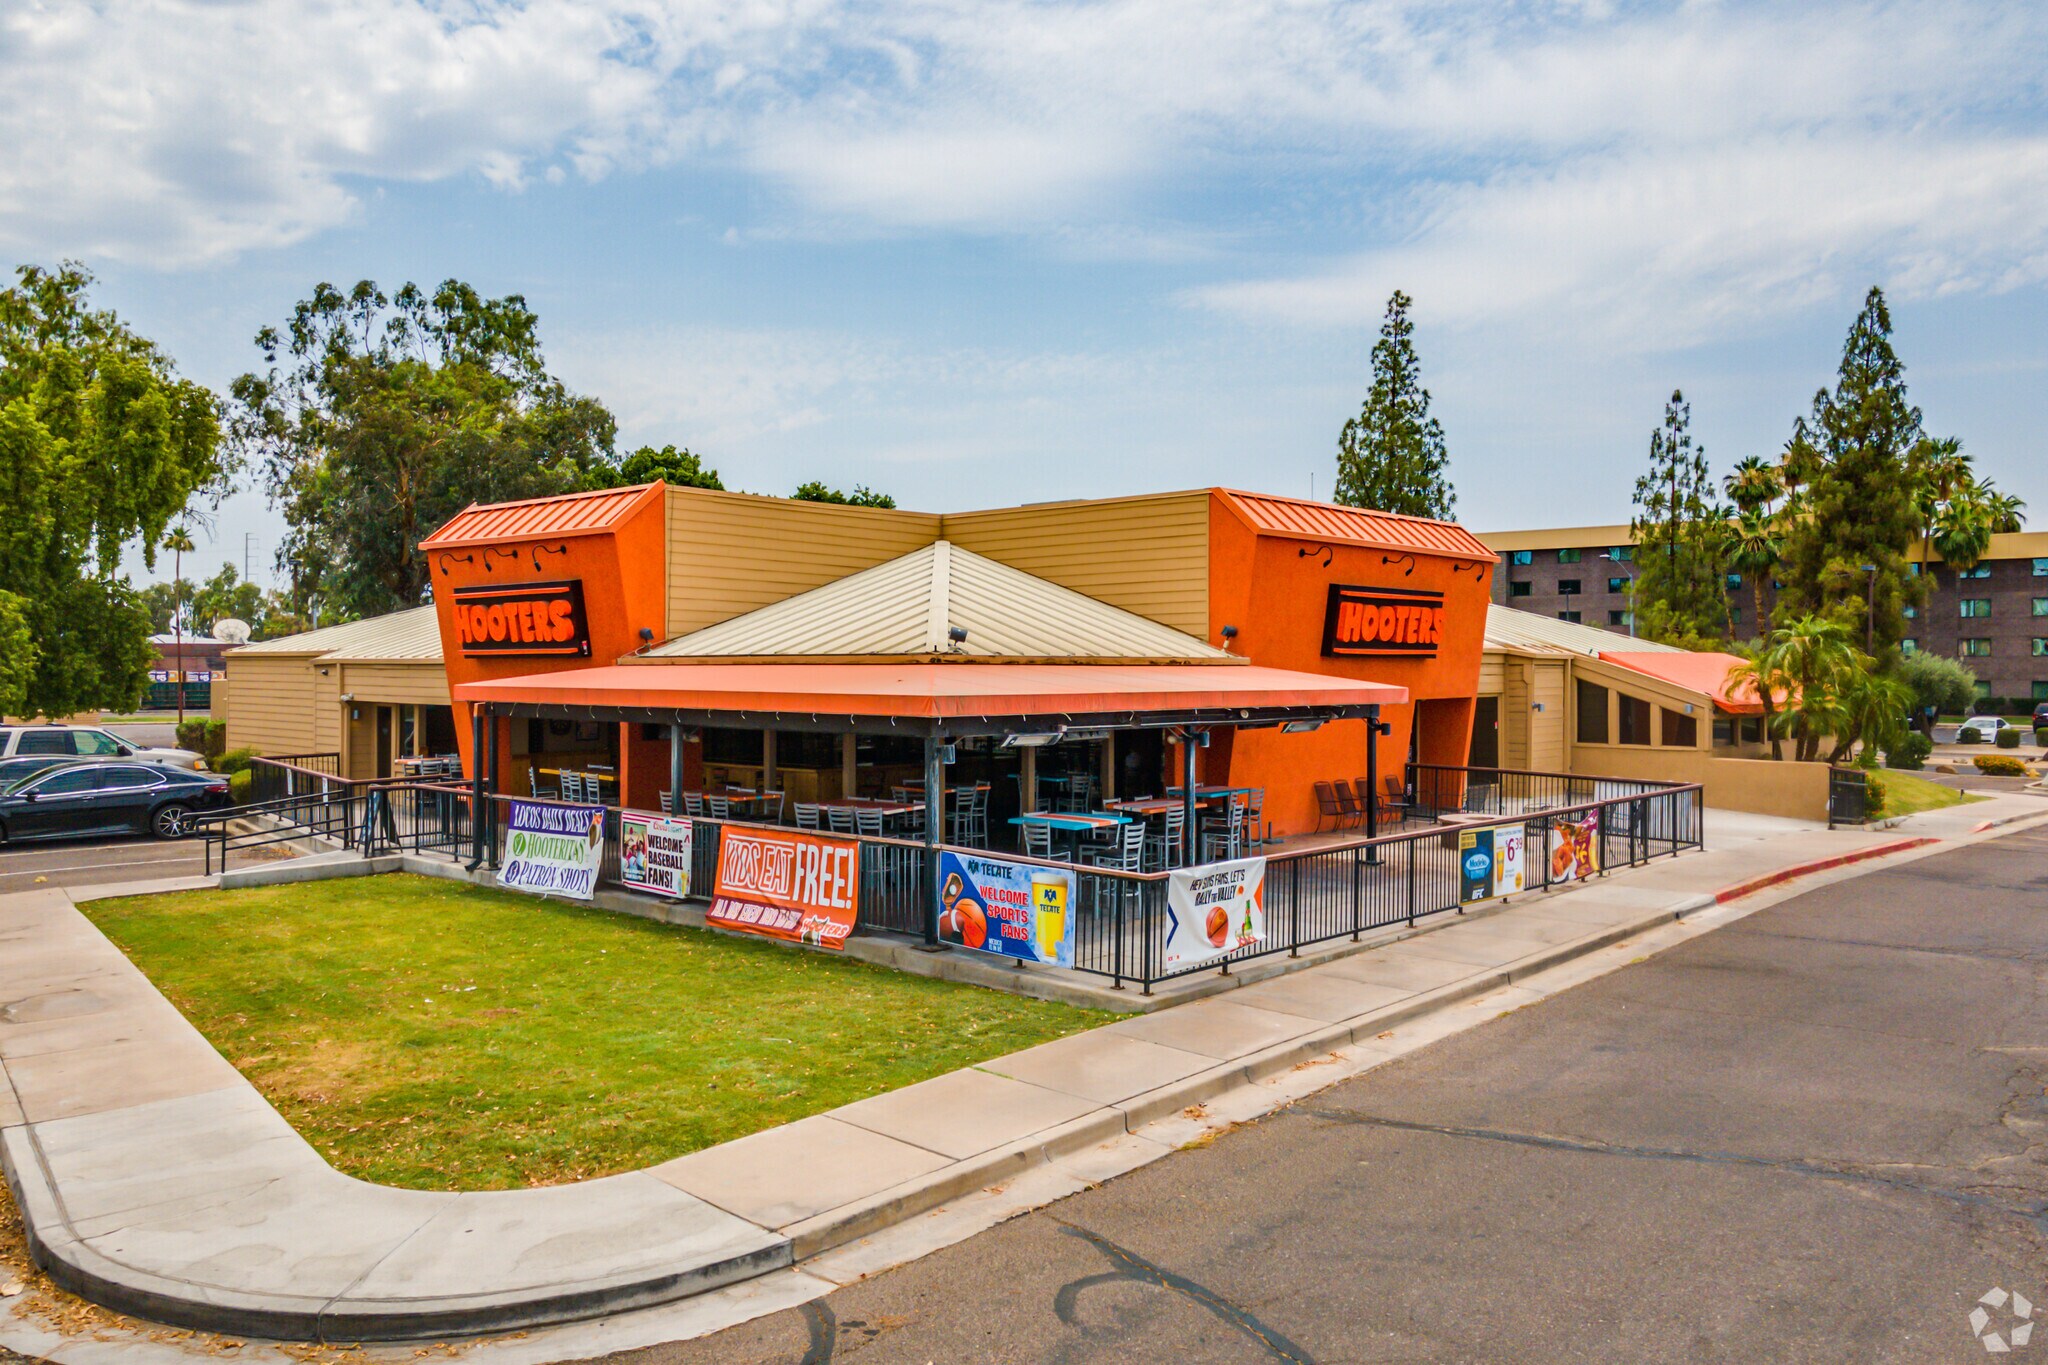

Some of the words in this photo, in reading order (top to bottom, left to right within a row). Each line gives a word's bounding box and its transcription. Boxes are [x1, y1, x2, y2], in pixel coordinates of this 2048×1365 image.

[453, 600, 575, 643] HOOTERS
[1336, 601, 1445, 644] HOOTERS
[513, 805, 541, 829] LOCOS
[541, 807, 566, 831] DAILY
[565, 809, 590, 833] DEALS
[526, 833, 586, 864] HOOTERITAS
[648, 834, 684, 853] WELCOME
[648, 851, 684, 870] BASEBALL
[981, 863, 1013, 879] TECATE
[518, 861, 559, 888] PATRÓN
[557, 868, 593, 894] SHOTS
[648, 867, 673, 889] FANS!
[722, 839, 761, 888] KIDS
[758, 845, 795, 894] EAT
[792, 843, 855, 909] FREE!
[1189, 878, 1203, 891] HEY
[1230, 868, 1246, 883] LET'S
[980, 885, 1029, 906] WELCOME
[1217, 884, 1238, 902] VALLEY
[987, 904, 1029, 924] SPORTS
[1039, 903, 1061, 914] TECATE
[1001, 923, 1029, 941] FANS
